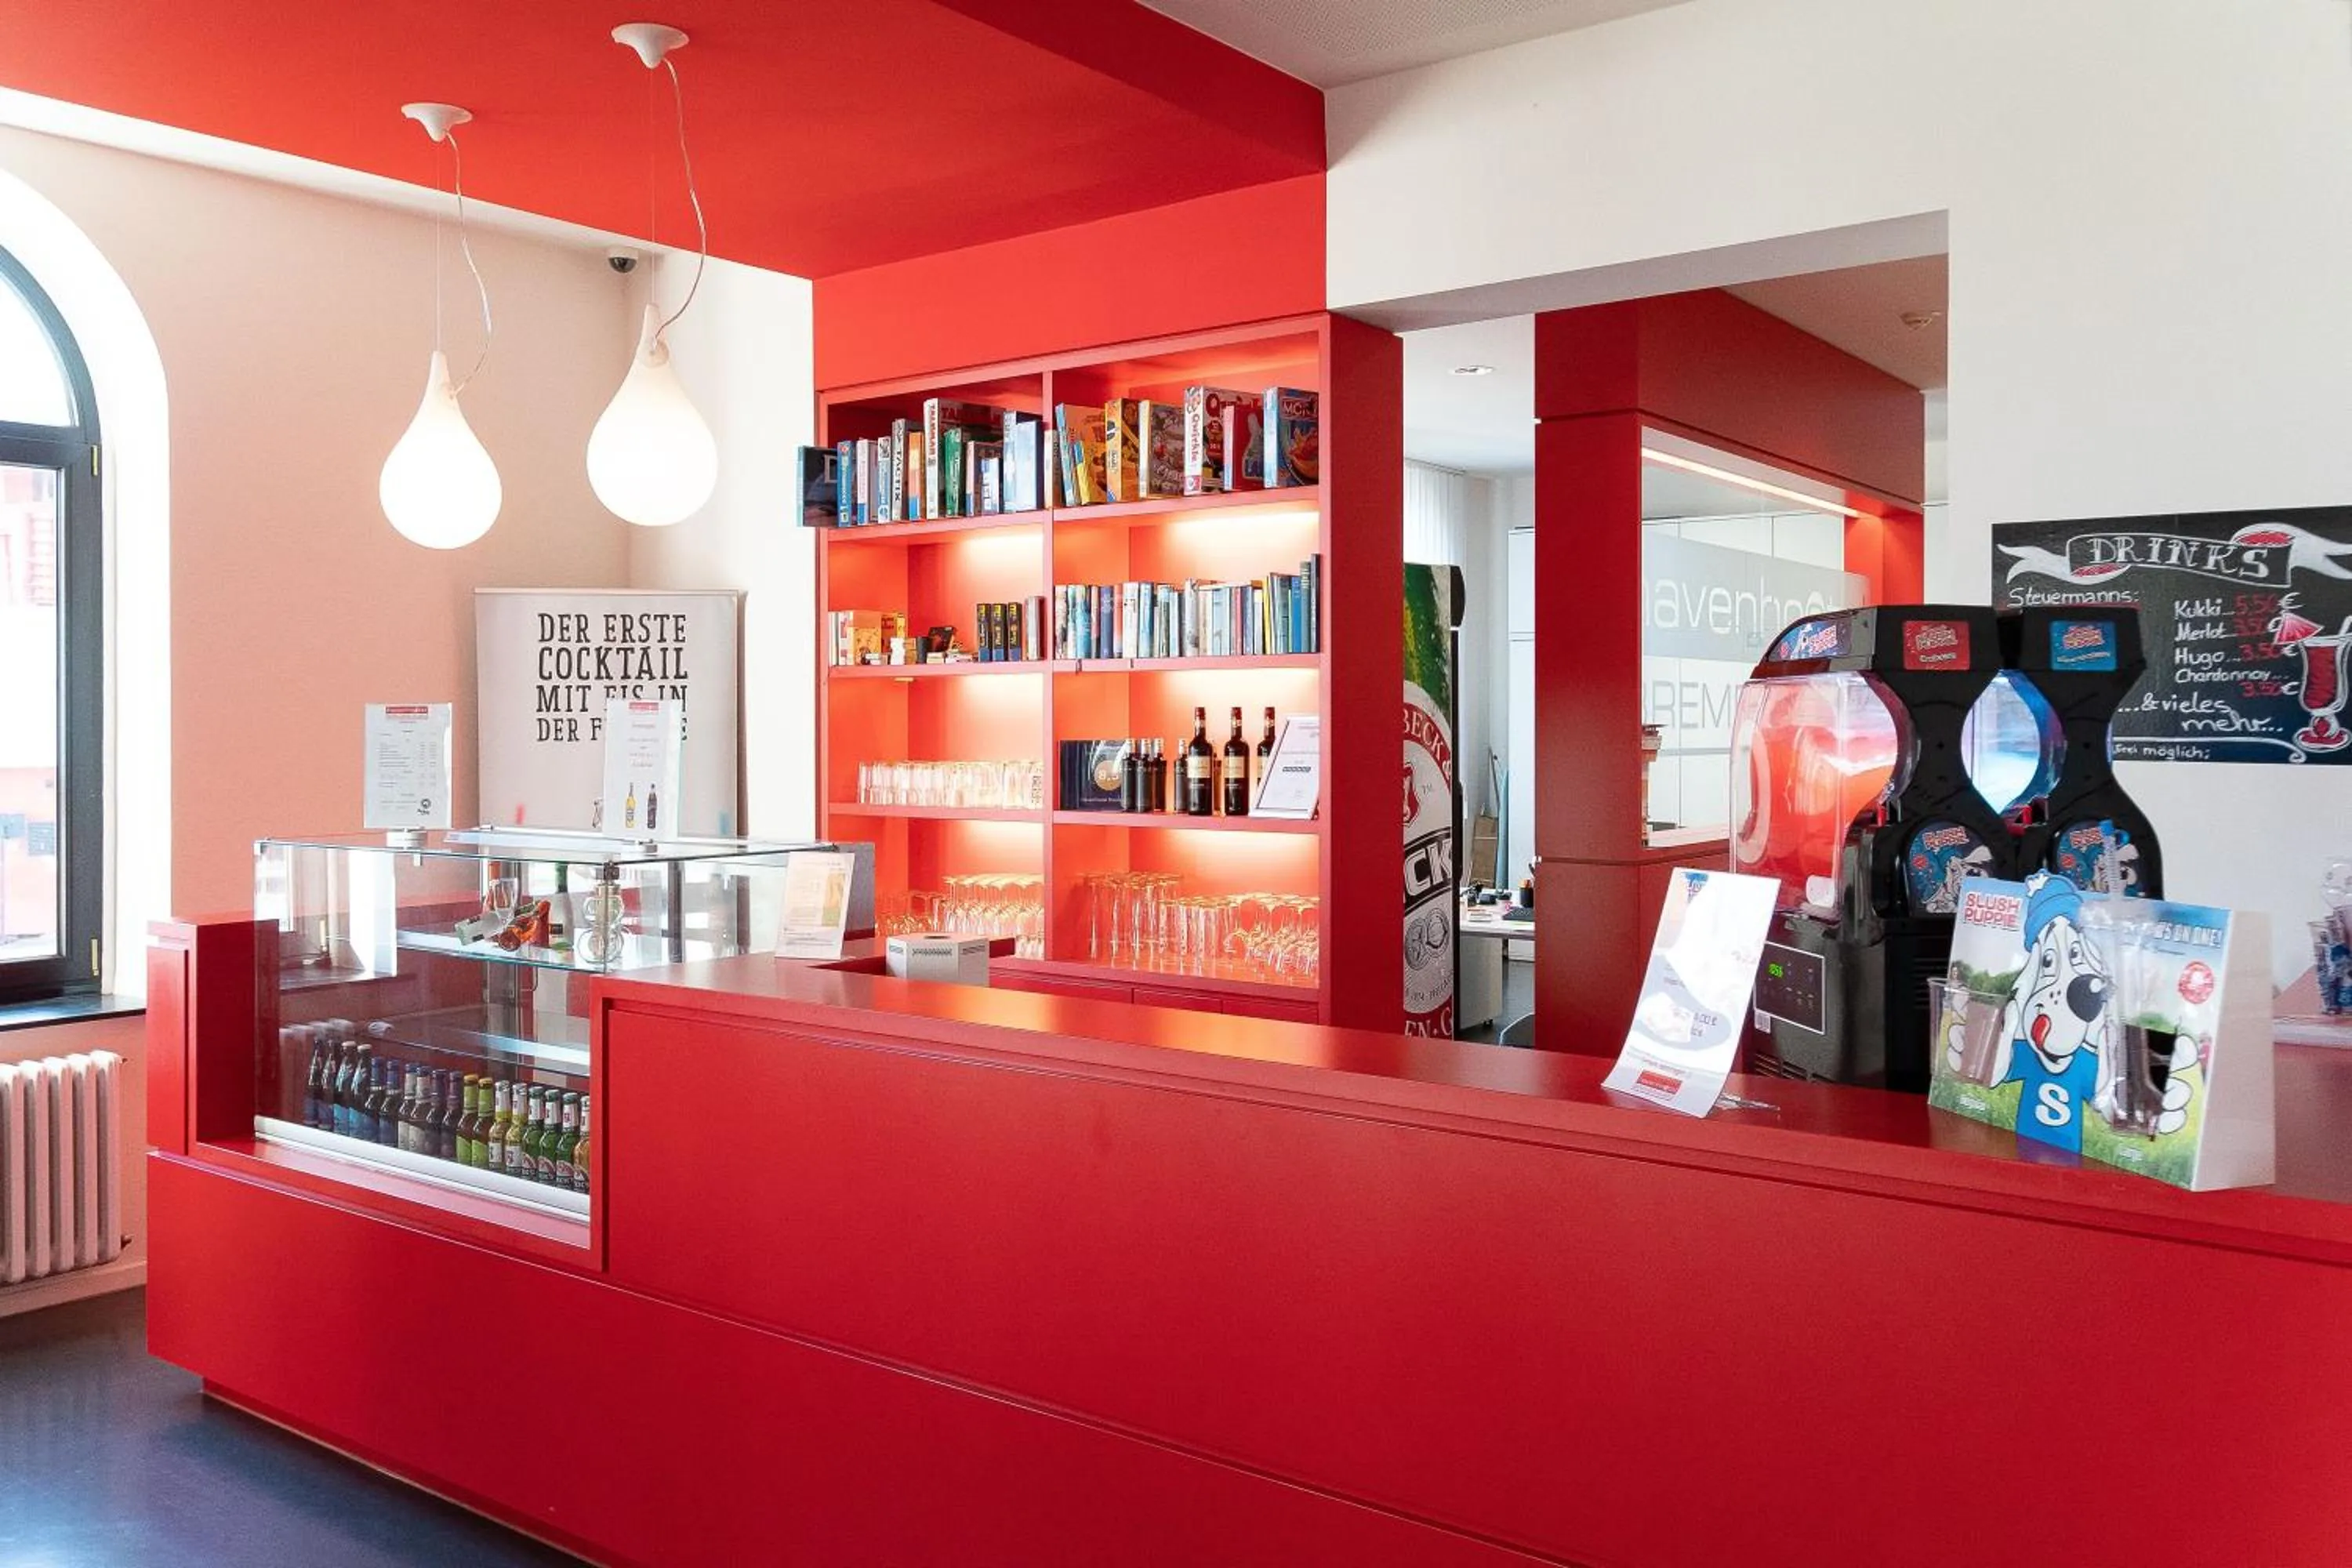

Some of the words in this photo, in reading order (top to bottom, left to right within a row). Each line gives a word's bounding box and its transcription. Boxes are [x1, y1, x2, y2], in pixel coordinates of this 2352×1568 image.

[2086, 536, 2270, 578] DRINKS
[538, 613, 591, 643] DER
[603, 614, 686, 643] ERSTE
[539, 646, 688, 681] COCKTAIL
[536, 684, 592, 712] MIT
[536, 717, 580, 742] DER
[1403, 707, 1443, 762] BECK
[1966, 893, 2020, 913] SLUSH
[1964, 907, 2020, 931] PUPPIE
[2035, 1083, 2071, 1126] S
